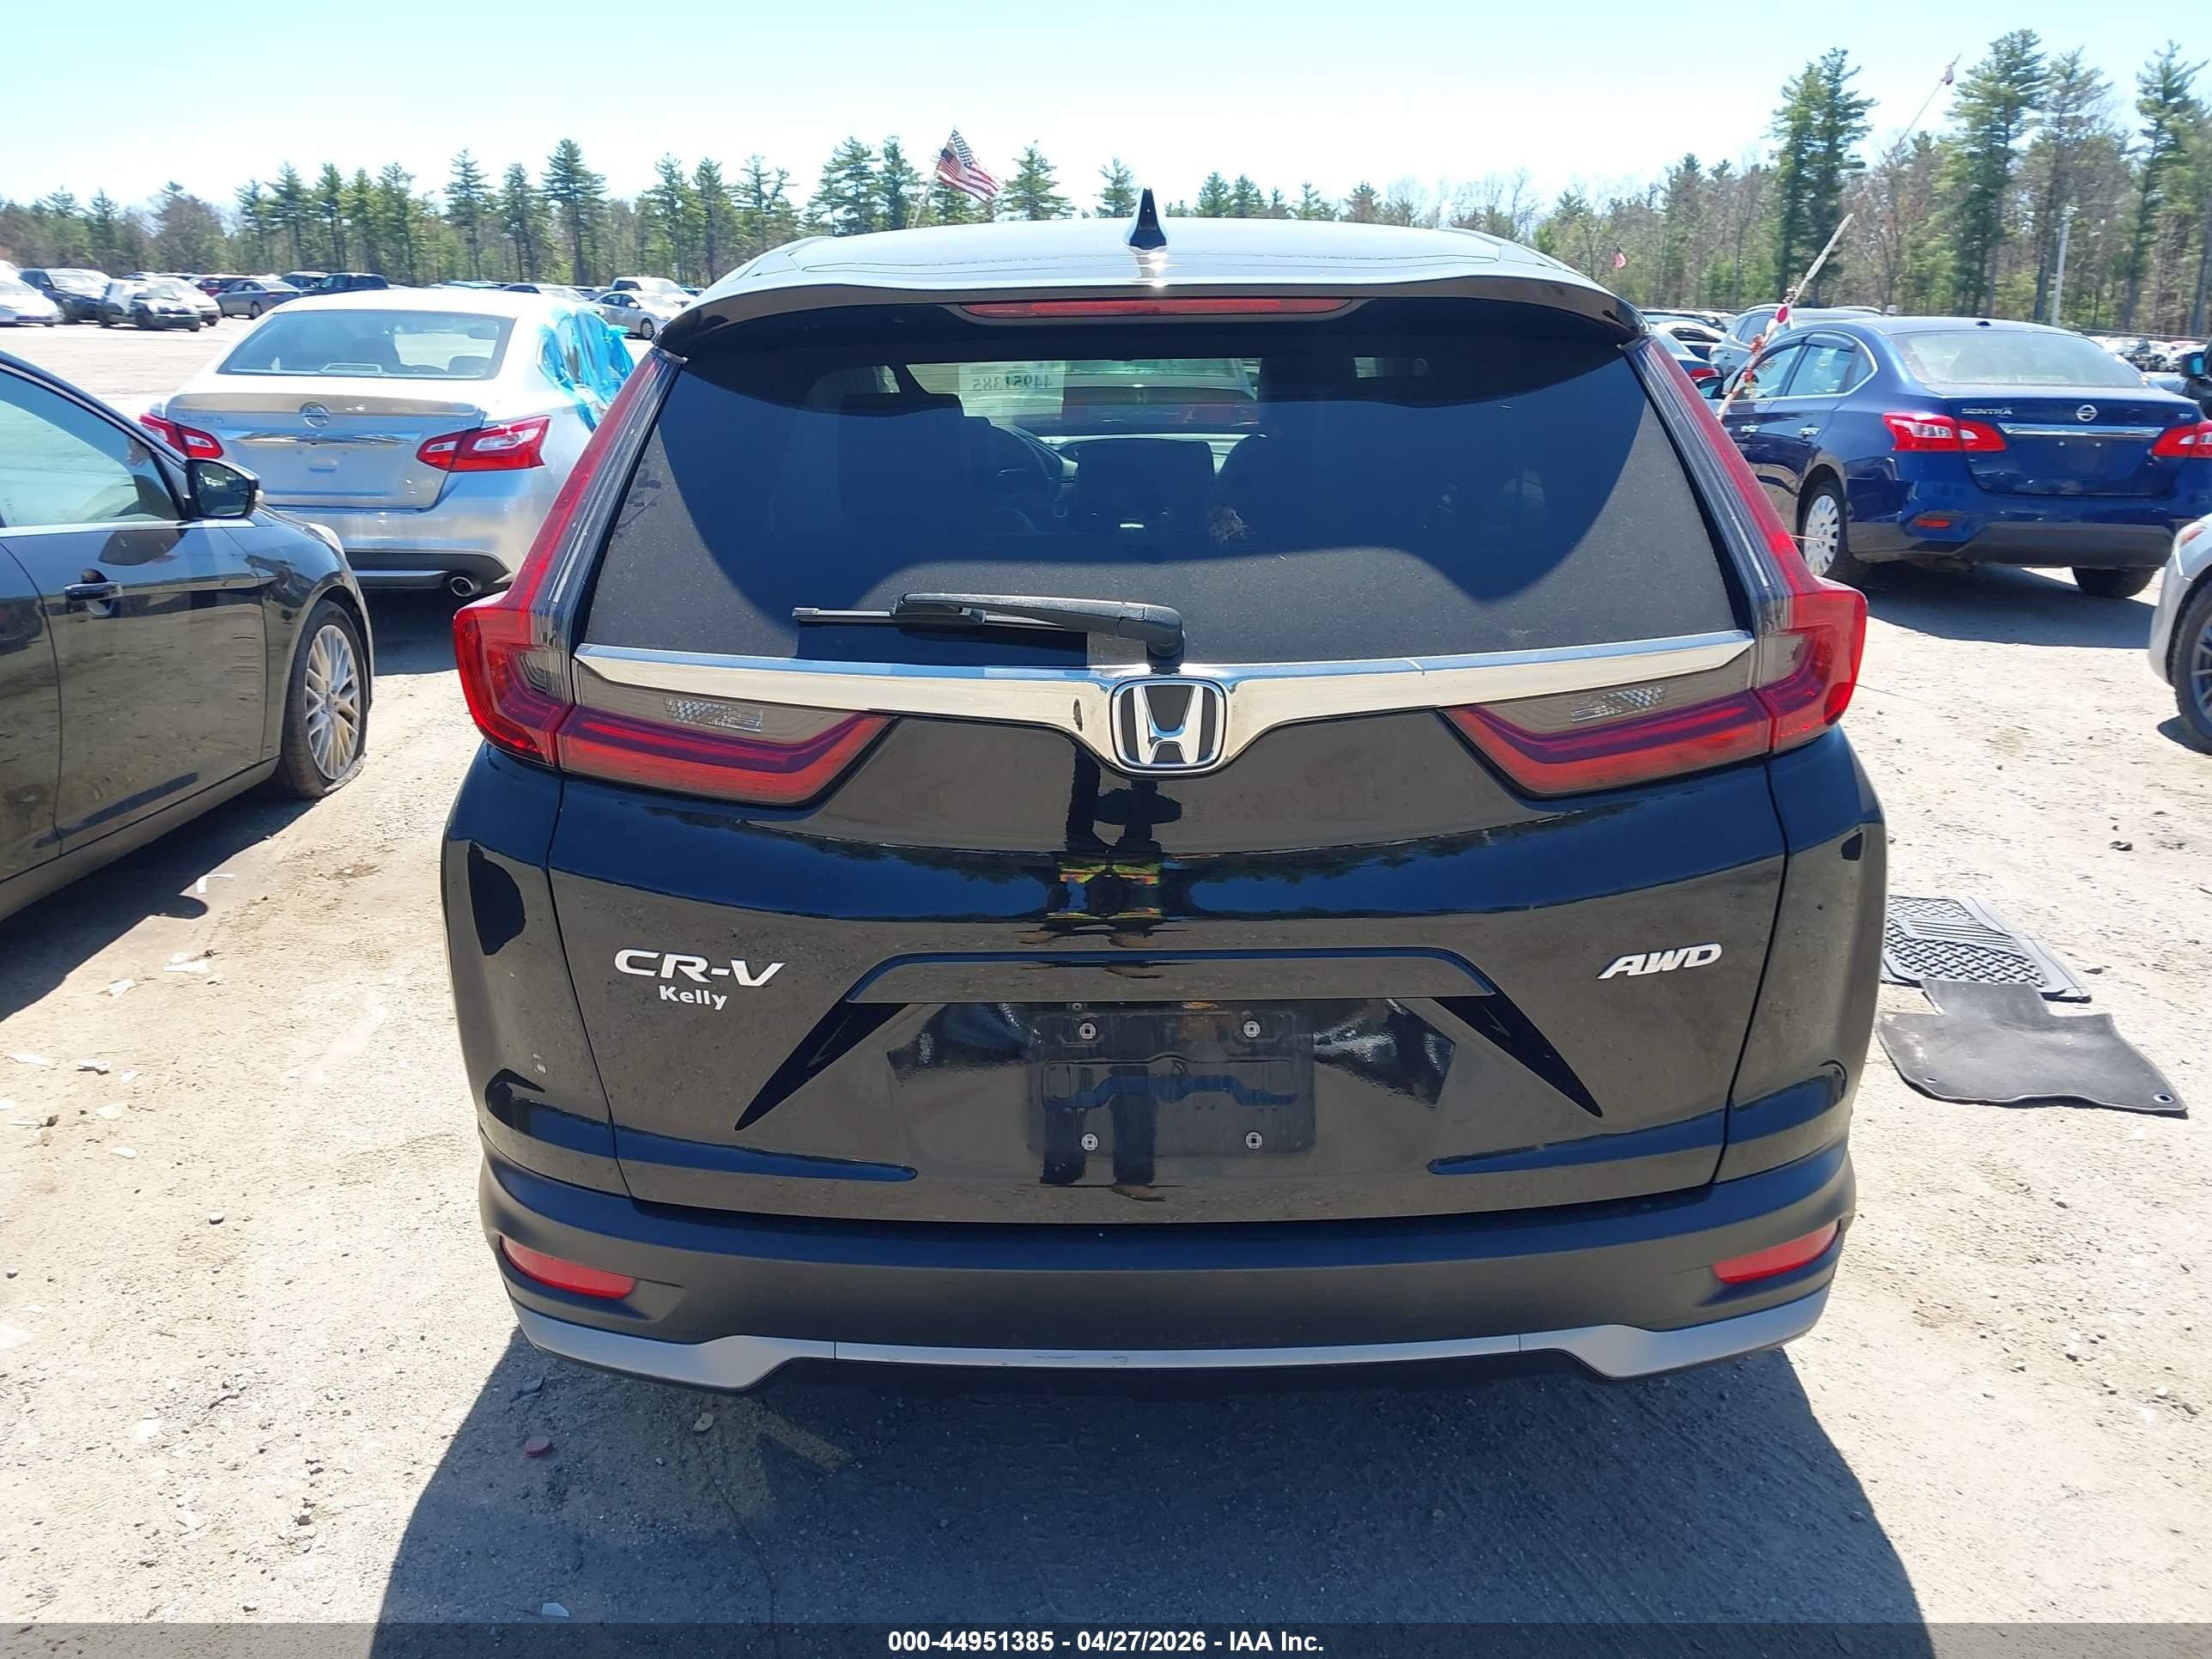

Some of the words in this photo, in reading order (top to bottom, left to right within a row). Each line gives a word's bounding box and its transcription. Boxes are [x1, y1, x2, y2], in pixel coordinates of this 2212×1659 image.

[614, 949, 787, 987] CR-V
[1597, 943, 1723, 980] AWD
[659, 985, 728, 1011] Kelly
